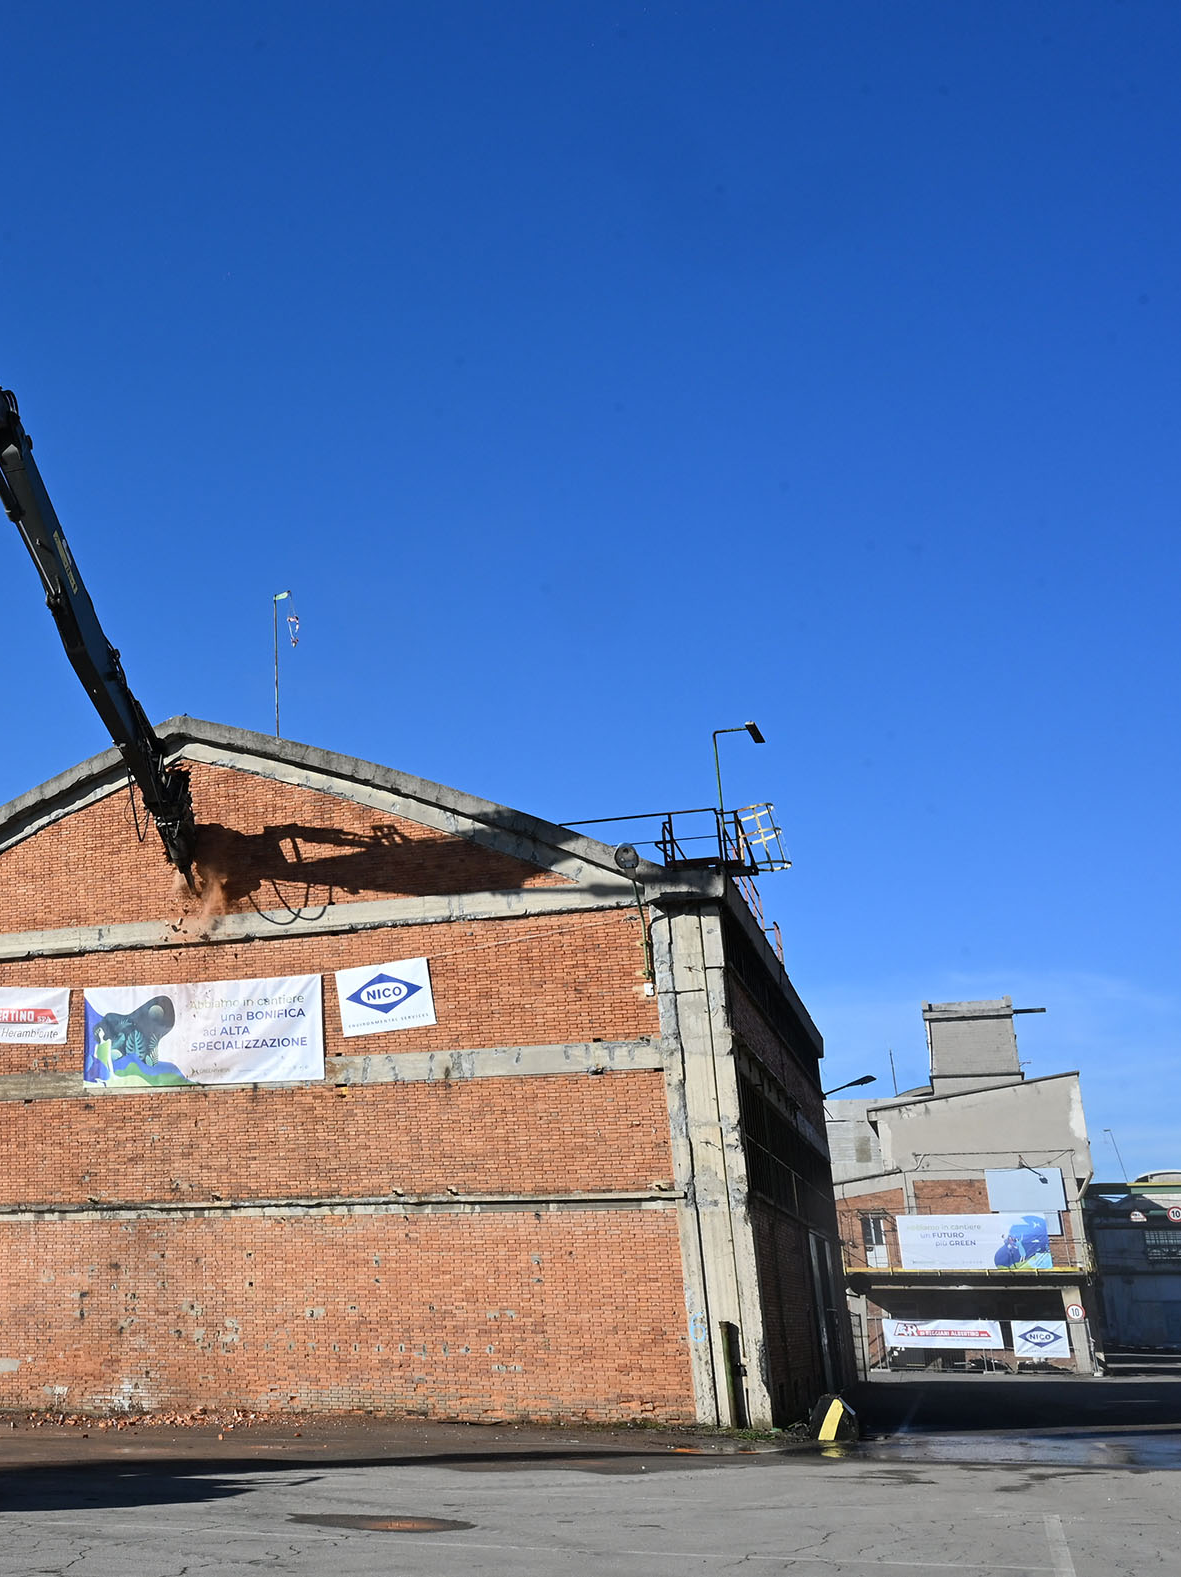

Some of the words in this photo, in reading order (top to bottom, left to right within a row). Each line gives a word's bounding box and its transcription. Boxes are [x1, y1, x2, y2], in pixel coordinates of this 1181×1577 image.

[366, 986, 402, 1001] NICO
[190, 999, 240, 1010] Abbiamo
[243, 998, 255, 1007] in
[257, 995, 305, 1007] cantiere
[221, 1013, 243, 1022] una
[246, 1008, 306, 1021] BONIFICA
[400, 1012, 429, 1021] SERVICES
[2, 1028, 59, 1039] Herambiente
[203, 1027, 217, 1037] ad
[220, 1026, 250, 1036] ALTA
[191, 1037, 308, 1052] SPECIALIZZAZIONE
[1171, 1210, 1181, 1218] 10
[932, 1231, 965, 1239] FUTURO
[949, 1239, 977, 1247] GREEN
[1071, 1307, 1080, 1317] 10
